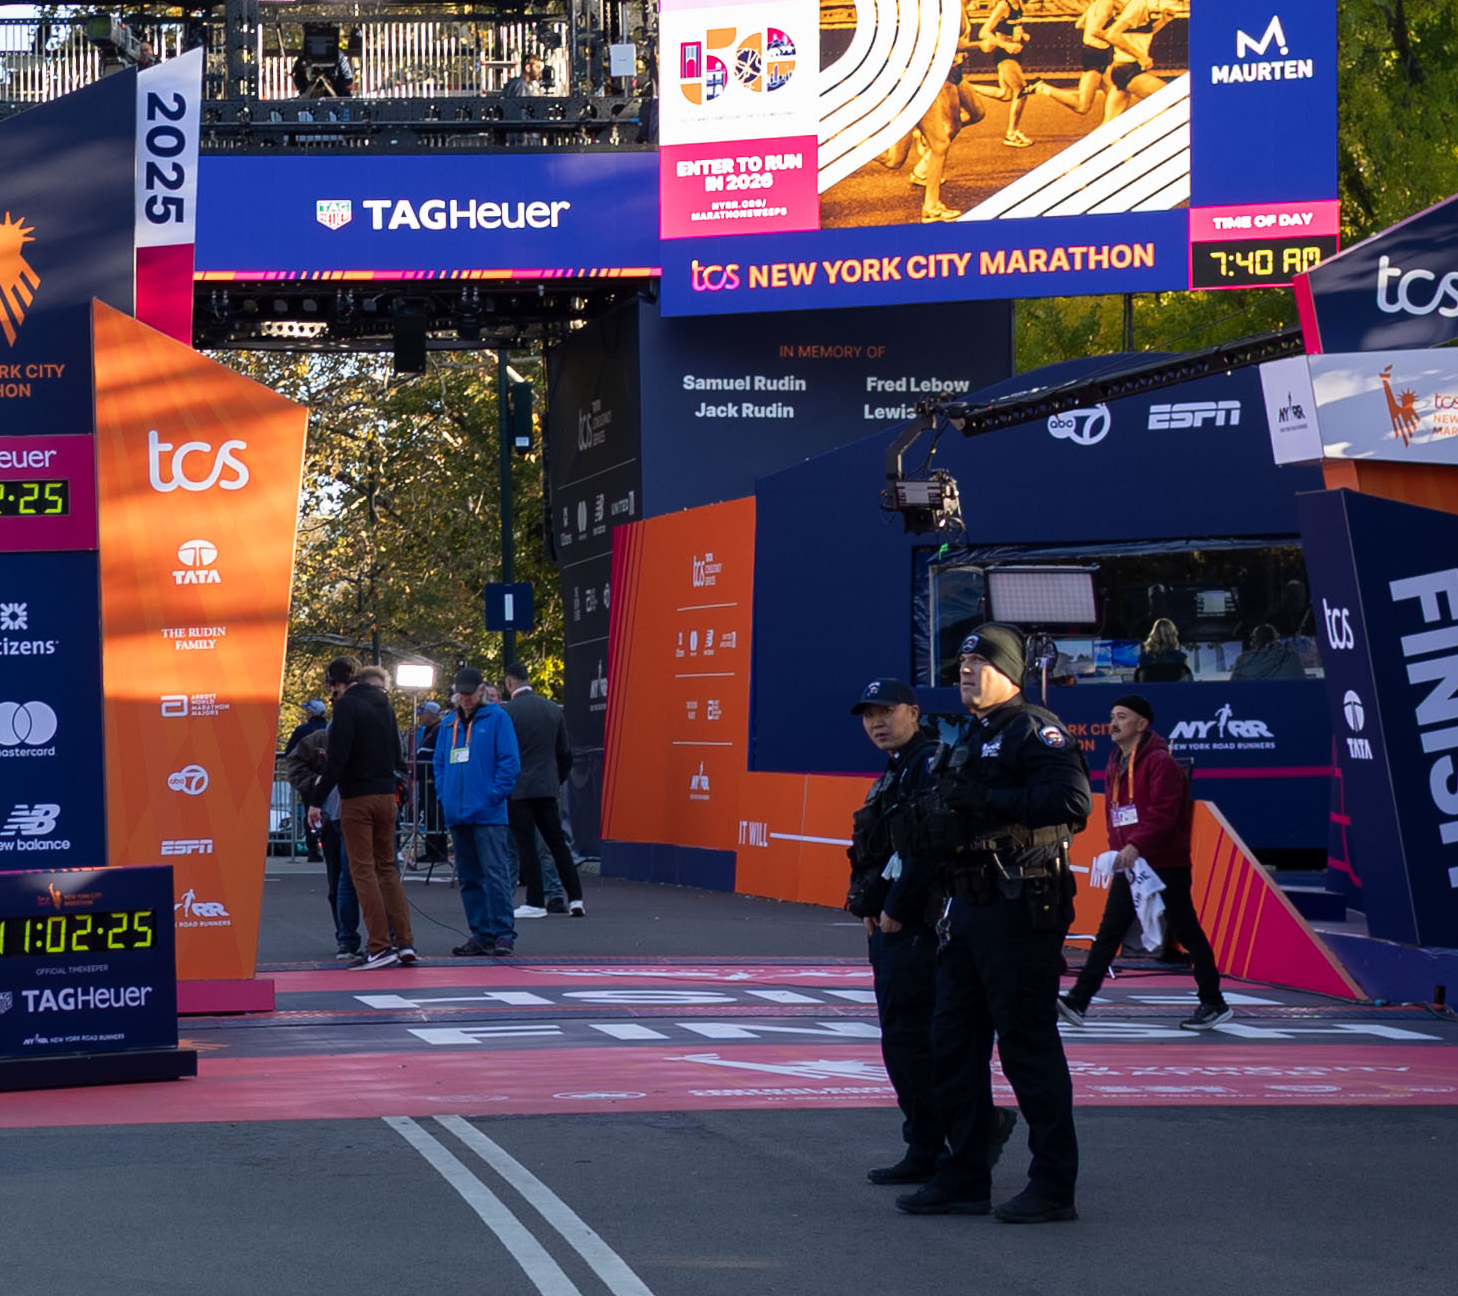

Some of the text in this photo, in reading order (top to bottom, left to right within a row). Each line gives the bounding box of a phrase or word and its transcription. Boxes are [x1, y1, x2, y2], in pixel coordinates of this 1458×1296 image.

[1211, 59, 1313, 85] MAURTEN
[144, 90, 186, 226] 2025
[676, 152, 803, 177] ENTER TO RUN
[704, 171, 774, 192] IN 2026
[1212, 212, 1314, 230] TIME OF DAY
[691, 243, 1155, 292] tcs NEW YORK CITY MARATHON
[1210, 246, 1321, 277] 7:40 AM
[779, 345, 886, 360] IN MEMORY OF
[24, 363, 65, 379] CITY
[682, 374, 807, 392] Samuel Rudin
[866, 375, 970, 393] Fred Lebow
[694, 401, 795, 420] Jack Rudin
[1147, 400, 1241, 431] ESPN
[148, 430, 250, 492] tcs
[172, 570, 221, 584] TATA
[161, 626, 226, 638] THE RUDIN
[1323, 597, 1354, 650] tcs
[175, 639, 216, 650] FAMILY
[1168, 720, 1275, 739] NYRR
[1237, 742, 1276, 750] RUNNERS
[1346, 738, 1373, 760] TATA
[18, 836, 71, 851] balance
[161, 839, 213, 855] ESPN
[36, 964, 109, 976] OFFICIAL TIMEKEEPER
[99, 1033, 125, 1041] RUNNERS
